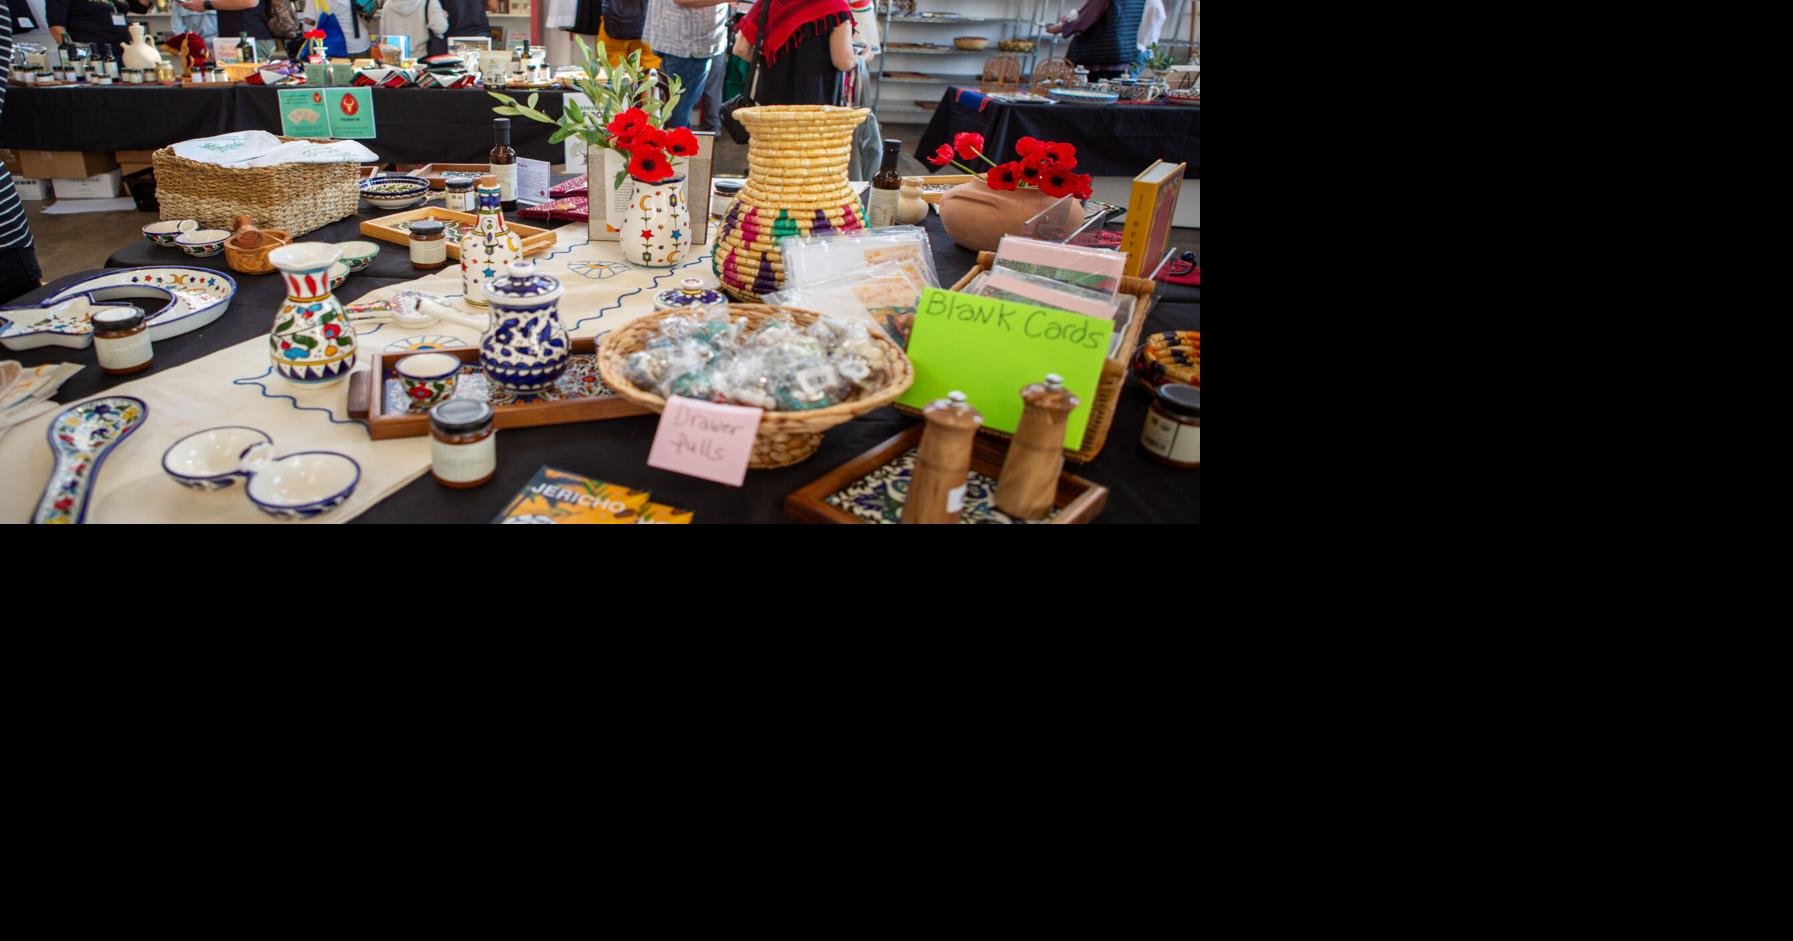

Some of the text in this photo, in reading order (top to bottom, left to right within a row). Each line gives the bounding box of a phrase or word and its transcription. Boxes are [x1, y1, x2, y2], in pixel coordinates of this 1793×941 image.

[1024, 310, 1105, 349] Cards
[674, 404, 745, 436] Drawer
[530, 483, 626, 513] JERICHO
